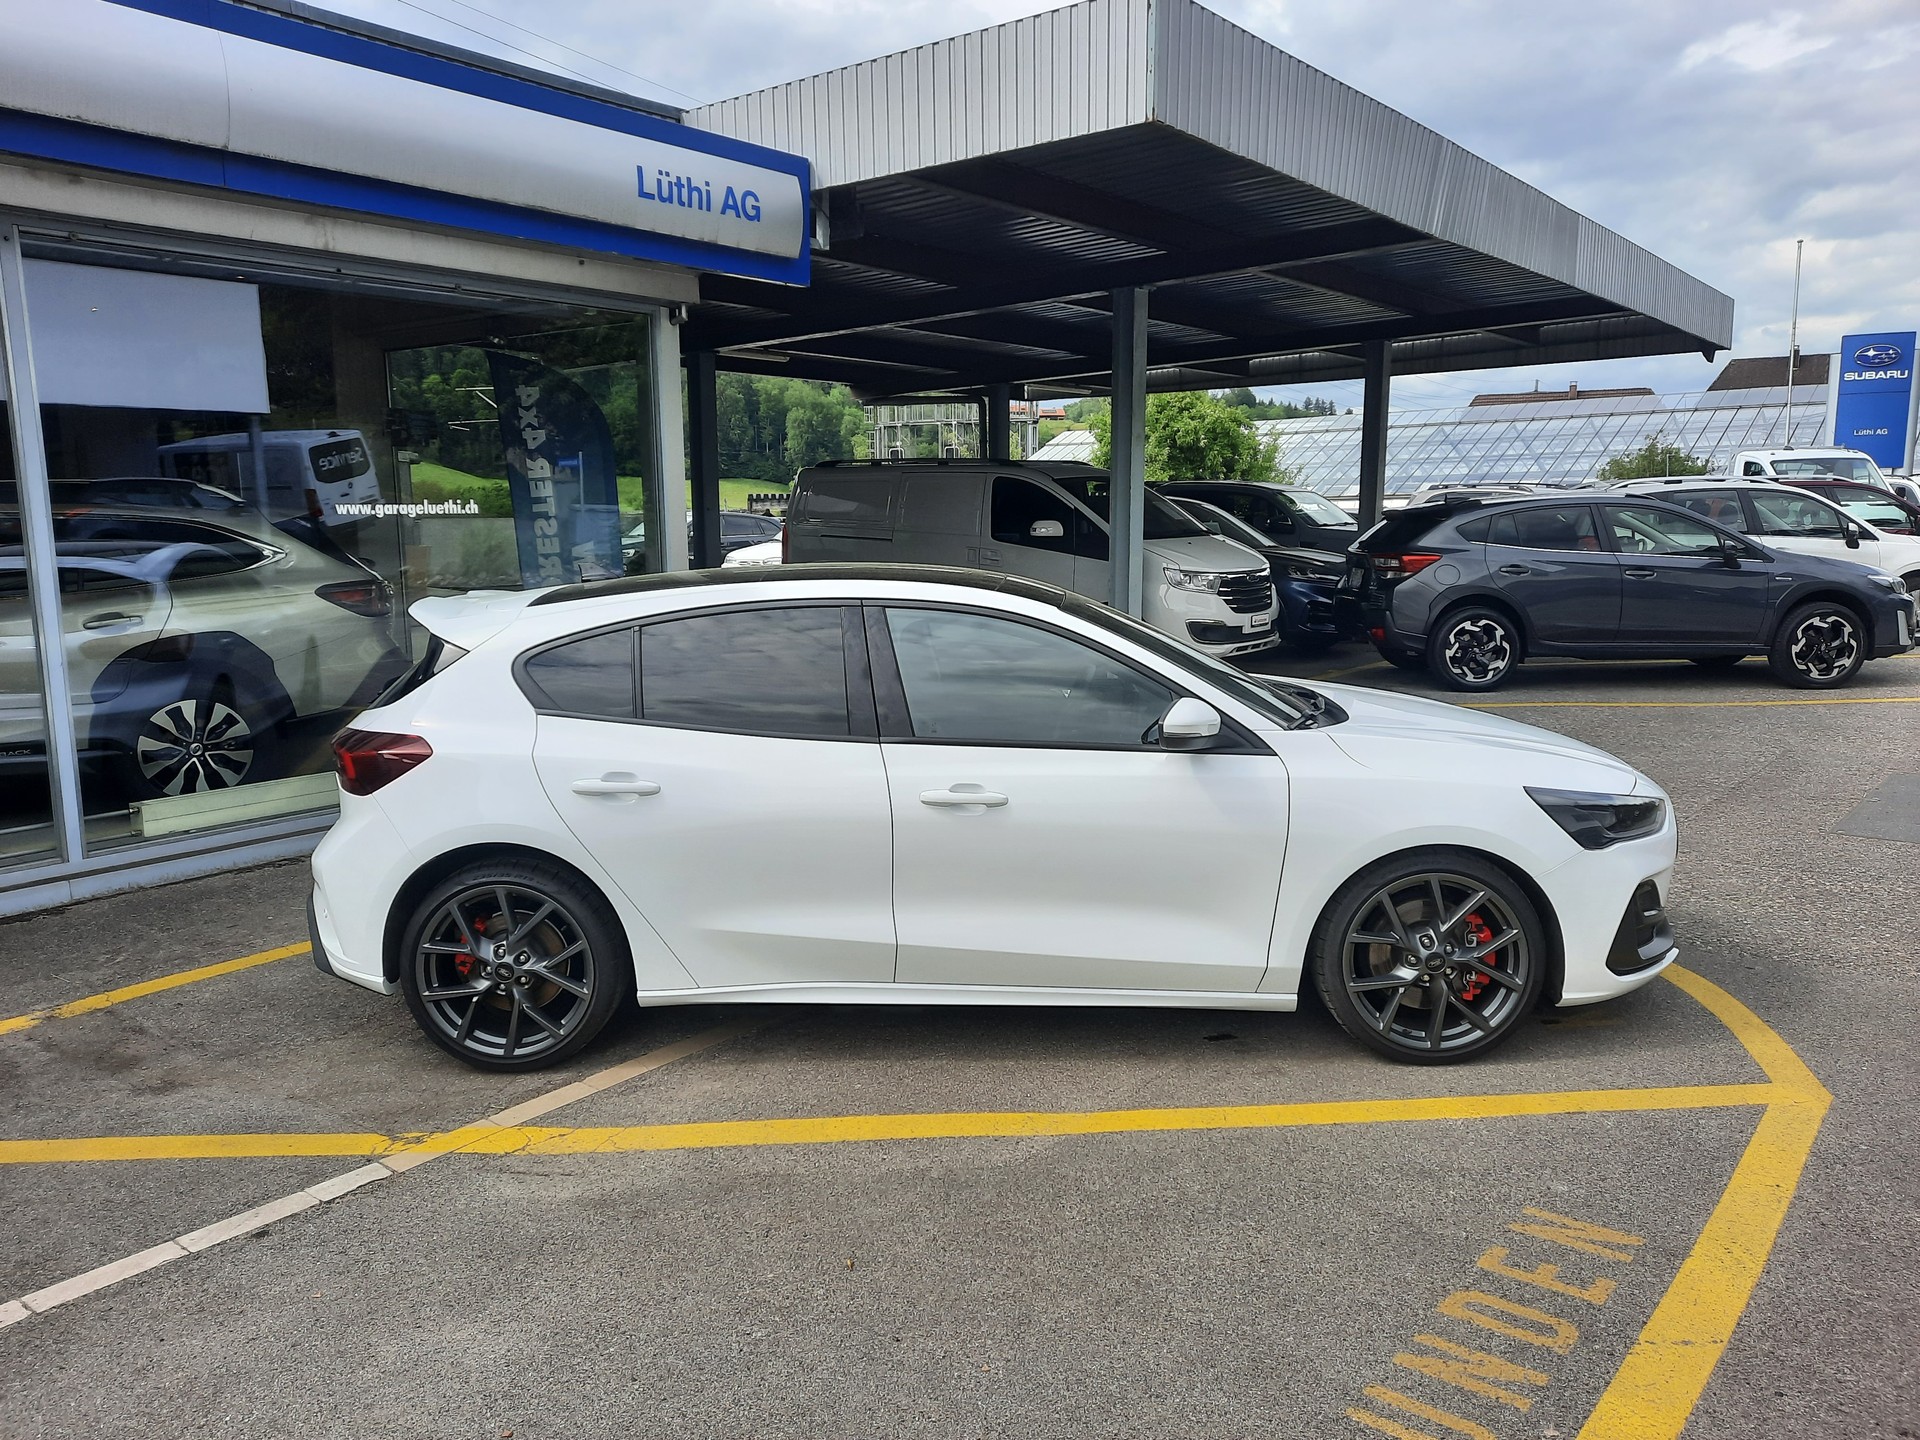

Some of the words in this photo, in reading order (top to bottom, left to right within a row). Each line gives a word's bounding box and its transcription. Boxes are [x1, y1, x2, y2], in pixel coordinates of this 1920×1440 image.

[636, 165, 712, 212] Lüthi
[720, 185, 761, 222] AG
[1843, 369, 1909, 381] SUBARU
[335, 499, 479, 518] www.garageluethi.ch
